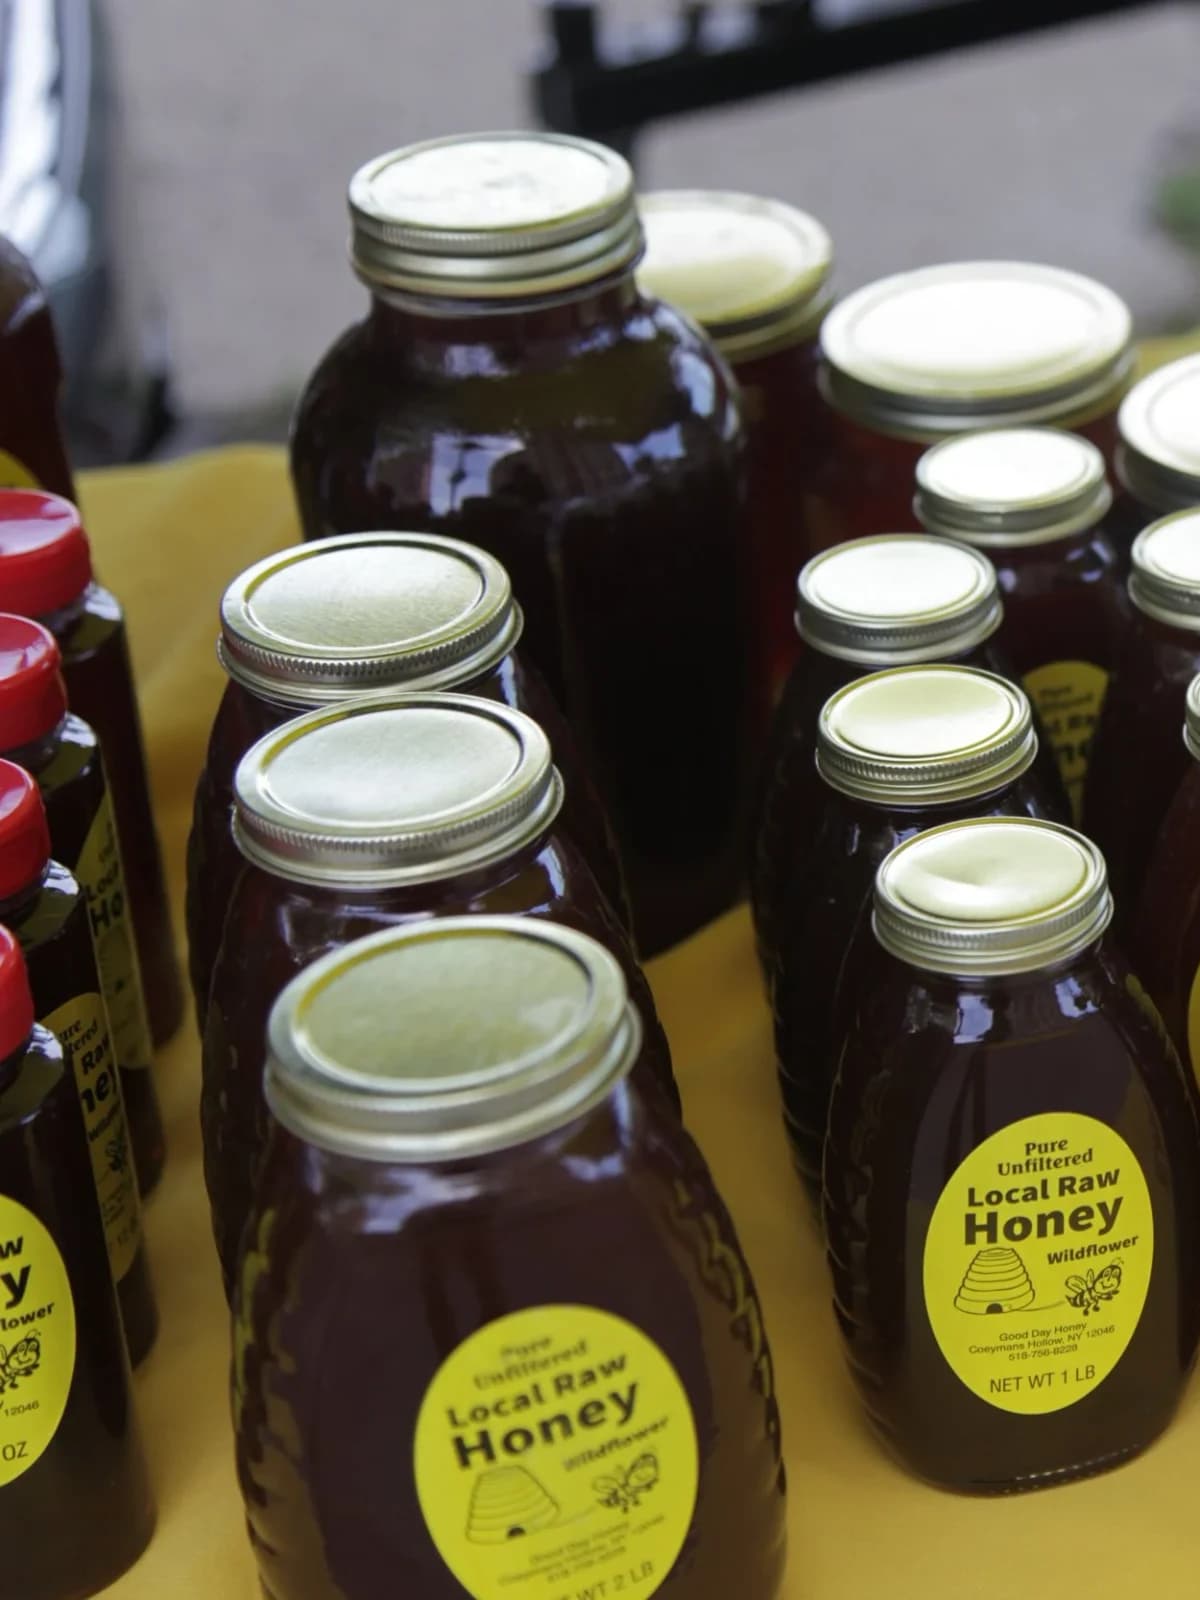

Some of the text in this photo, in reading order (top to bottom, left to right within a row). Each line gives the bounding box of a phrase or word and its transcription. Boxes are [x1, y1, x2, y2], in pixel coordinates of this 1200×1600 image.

[998, 1148, 1093, 1176] Unfiltered
[1025, 1139, 1068, 1156] Pure
[968, 1168, 1120, 1207] Local Raw
[964, 1196, 1124, 1246] Honey
[1047, 1235, 1139, 1265] Wildflower
[0, 1302, 55, 1332] lower
[999, 1330, 1029, 1342] Good
[1031, 1328, 1052, 1338] Day
[1067, 1332, 1083, 1341] NY
[446, 1354, 627, 1429] Local Raw
[989, 1364, 1095, 1394] NET WT 1 LB
[452, 1381, 639, 1471] Honey
[2, 1440, 28, 1462] OZ
